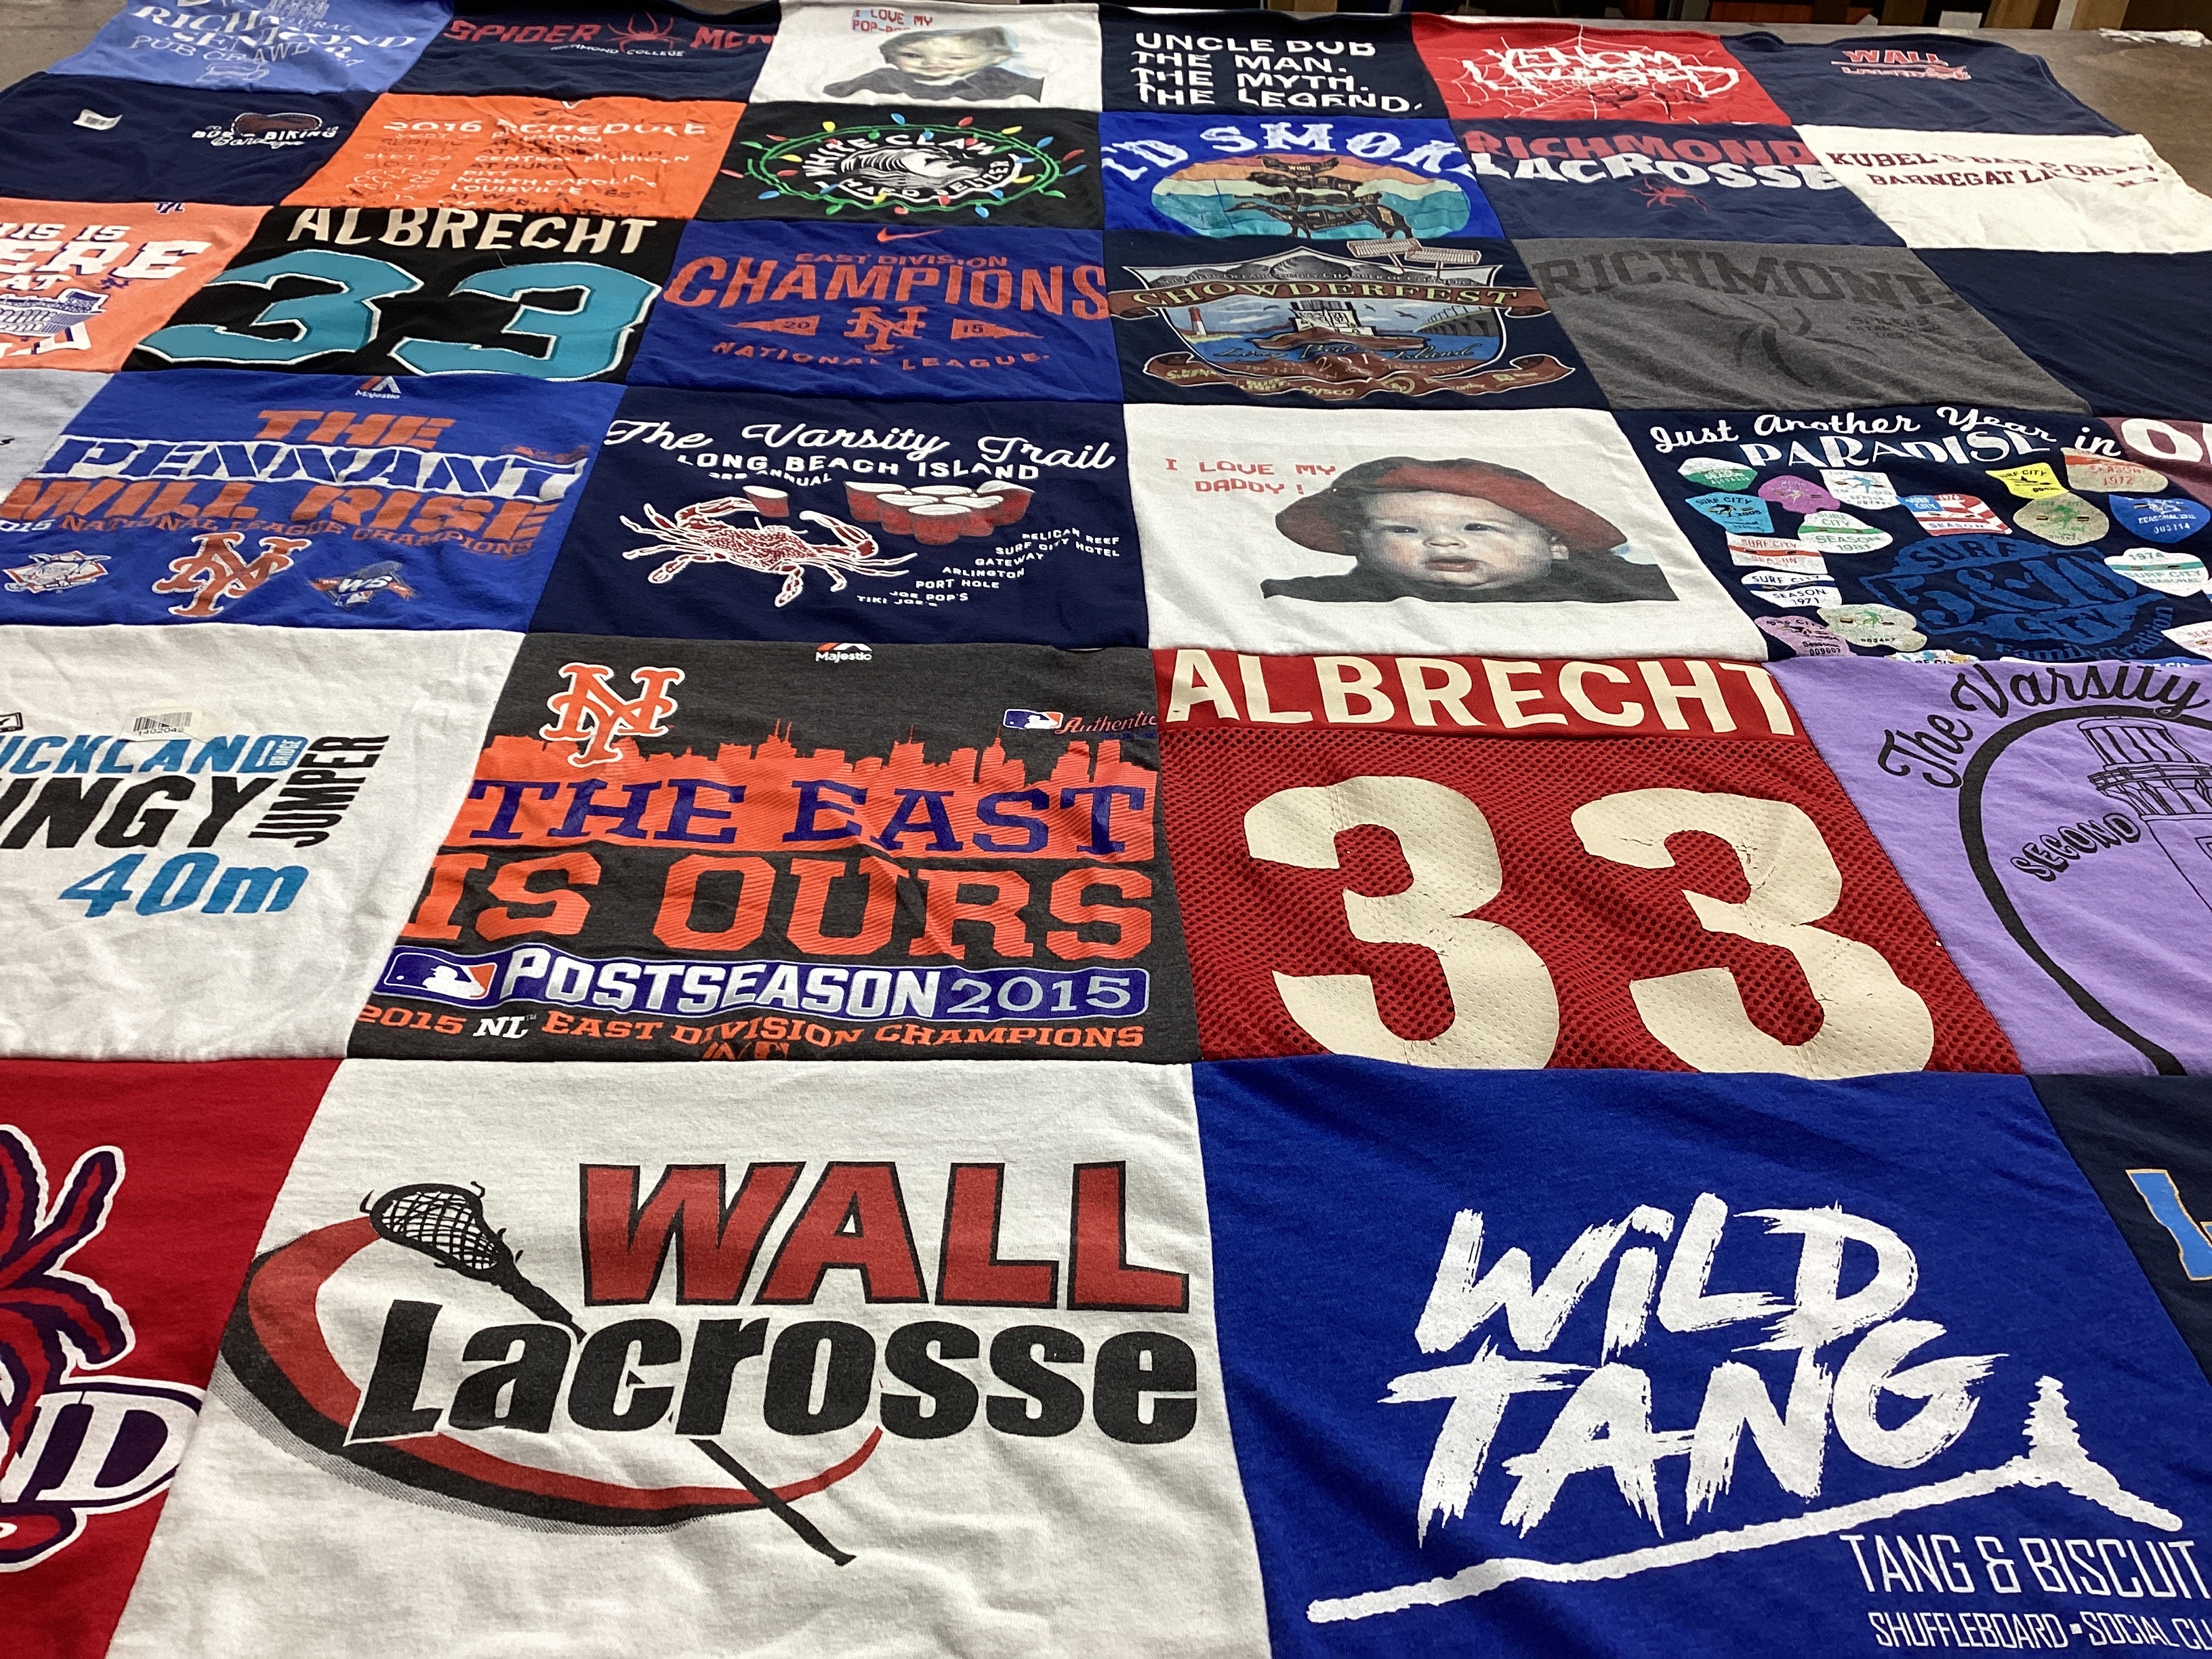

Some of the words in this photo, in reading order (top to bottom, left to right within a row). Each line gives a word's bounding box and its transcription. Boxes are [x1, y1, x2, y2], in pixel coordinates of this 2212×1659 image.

[871, 9, 904, 25] LOVE
[914, 16, 933, 26] MY
[443, 20, 601, 43] SPIDER
[1135, 33, 1274, 52] UNCLE
[1286, 40, 1376, 56] DUB
[129, 35, 197, 56] PUB
[1131, 52, 1211, 68] THE
[1235, 54, 1347, 73] MAN.
[1131, 68, 1212, 87] THE
[1237, 73, 1368, 93] MYTH.
[1134, 83, 1215, 105] THE
[1237, 88, 1422, 112] LEGEND.
[384, 121, 482, 132] 2016
[802, 138, 878, 177] WHITE
[885, 134, 996, 155] CLAW
[1463, 131, 1817, 165] RICHMOND
[1471, 153, 1843, 190] LACROSSE
[1866, 171, 2013, 186] BARNEGAT
[75, 224, 131, 241] IS
[287, 208, 657, 254] ALBRECHT
[795, 253, 871, 265] EAST
[878, 253, 1008, 268] DIVISION
[663, 255, 1111, 321] CHAMPIONS
[1133, 283, 1518, 306] CHOWDERFEST
[137, 249, 662, 382] 33
[785, 321, 810, 331] 20
[963, 323, 984, 335] 15
[712, 342, 880, 365] NATIONAL
[902, 353, 1040, 371] LEAGUE
[254, 410, 456, 449] THE
[1650, 419, 1739, 453] Just
[1754, 412, 1921, 436] Another
[1936, 407, 2056, 442] Year
[2074, 427, 2121, 456] in
[604, 420, 713, 450] The
[742, 423, 950, 461] Varsity
[977, 436, 1115, 469] Trail
[32, 435, 588, 501] PENNANT
[677, 453, 768, 471] LONG
[785, 455, 898, 475] BEACH
[918, 459, 1039, 480] ISLAND
[755, 470, 832, 487] ANNUAL
[1166, 459, 1177, 471] I
[1199, 462, 1274, 475] LOVE
[1296, 464, 1336, 476] MY
[0, 479, 259, 520] WILL
[291, 485, 560, 541] RISE
[1723, 497, 1752, 505] CITY
[1822, 518, 1851, 527] CITY
[996, 541, 1031, 555] SURF
[1039, 539, 1069, 550] CITY
[1076, 541, 1119, 556] HOTEL
[1022, 528, 1080, 540] PELICAN
[1086, 535, 1119, 546] REEF
[1815, 535, 1881, 544] SEASON
[943, 567, 1024, 578] ARLINGTON
[975, 553, 1044, 567] GATEWAY
[916, 579, 954, 589] PORT
[962, 579, 999, 589] HOLE
[1751, 575, 1784, 583] SURF
[857, 596, 886, 605] TIKI
[889, 591, 918, 599] JOE
[926, 593, 968, 602] POP'S
[1773, 589, 1826, 599] SEASON
[1791, 596, 1820, 605] 1971
[815, 651, 872, 663] Majestic
[1166, 649, 1796, 736] ALBRECHT
[1054, 710, 1158, 735] Authentic
[1878, 714, 1973, 788] The
[1951, 663, 2211, 718] Varsity
[248, 735, 390, 848] JUMPER
[468, 779, 747, 844] THE
[783, 779, 1145, 854] EAST
[2011, 814, 2142, 882] SECOND
[58, 853, 309, 918] 40m
[401, 852, 601, 941] IS
[653, 854, 1152, 961] OURS
[1245, 775, 1933, 1080] 33
[499, 947, 941, 1018] POSTSEASON
[947, 976, 1131, 1015] 2015
[359, 1004, 467, 1035] 2015
[542, 1010, 663, 1040] EAST
[671, 1015, 863, 1048] DIVISION
[876, 1023, 1145, 1048] CHAMPIONS
[580, 1161, 1189, 1312] WALL
[346, 1298, 1197, 1444] Lacrosse
[1378, 1319, 2009, 1549] TANG
[1839, 1534, 1975, 1593] TANG
[1975, 1536, 2022, 1594] &
[2020, 1538, 2211, 1599] BISCUIT
[1868, 1612, 2069, 1649] SHUFFLEBOARD
[2081, 1611, 2180, 1648] SOCIAL
